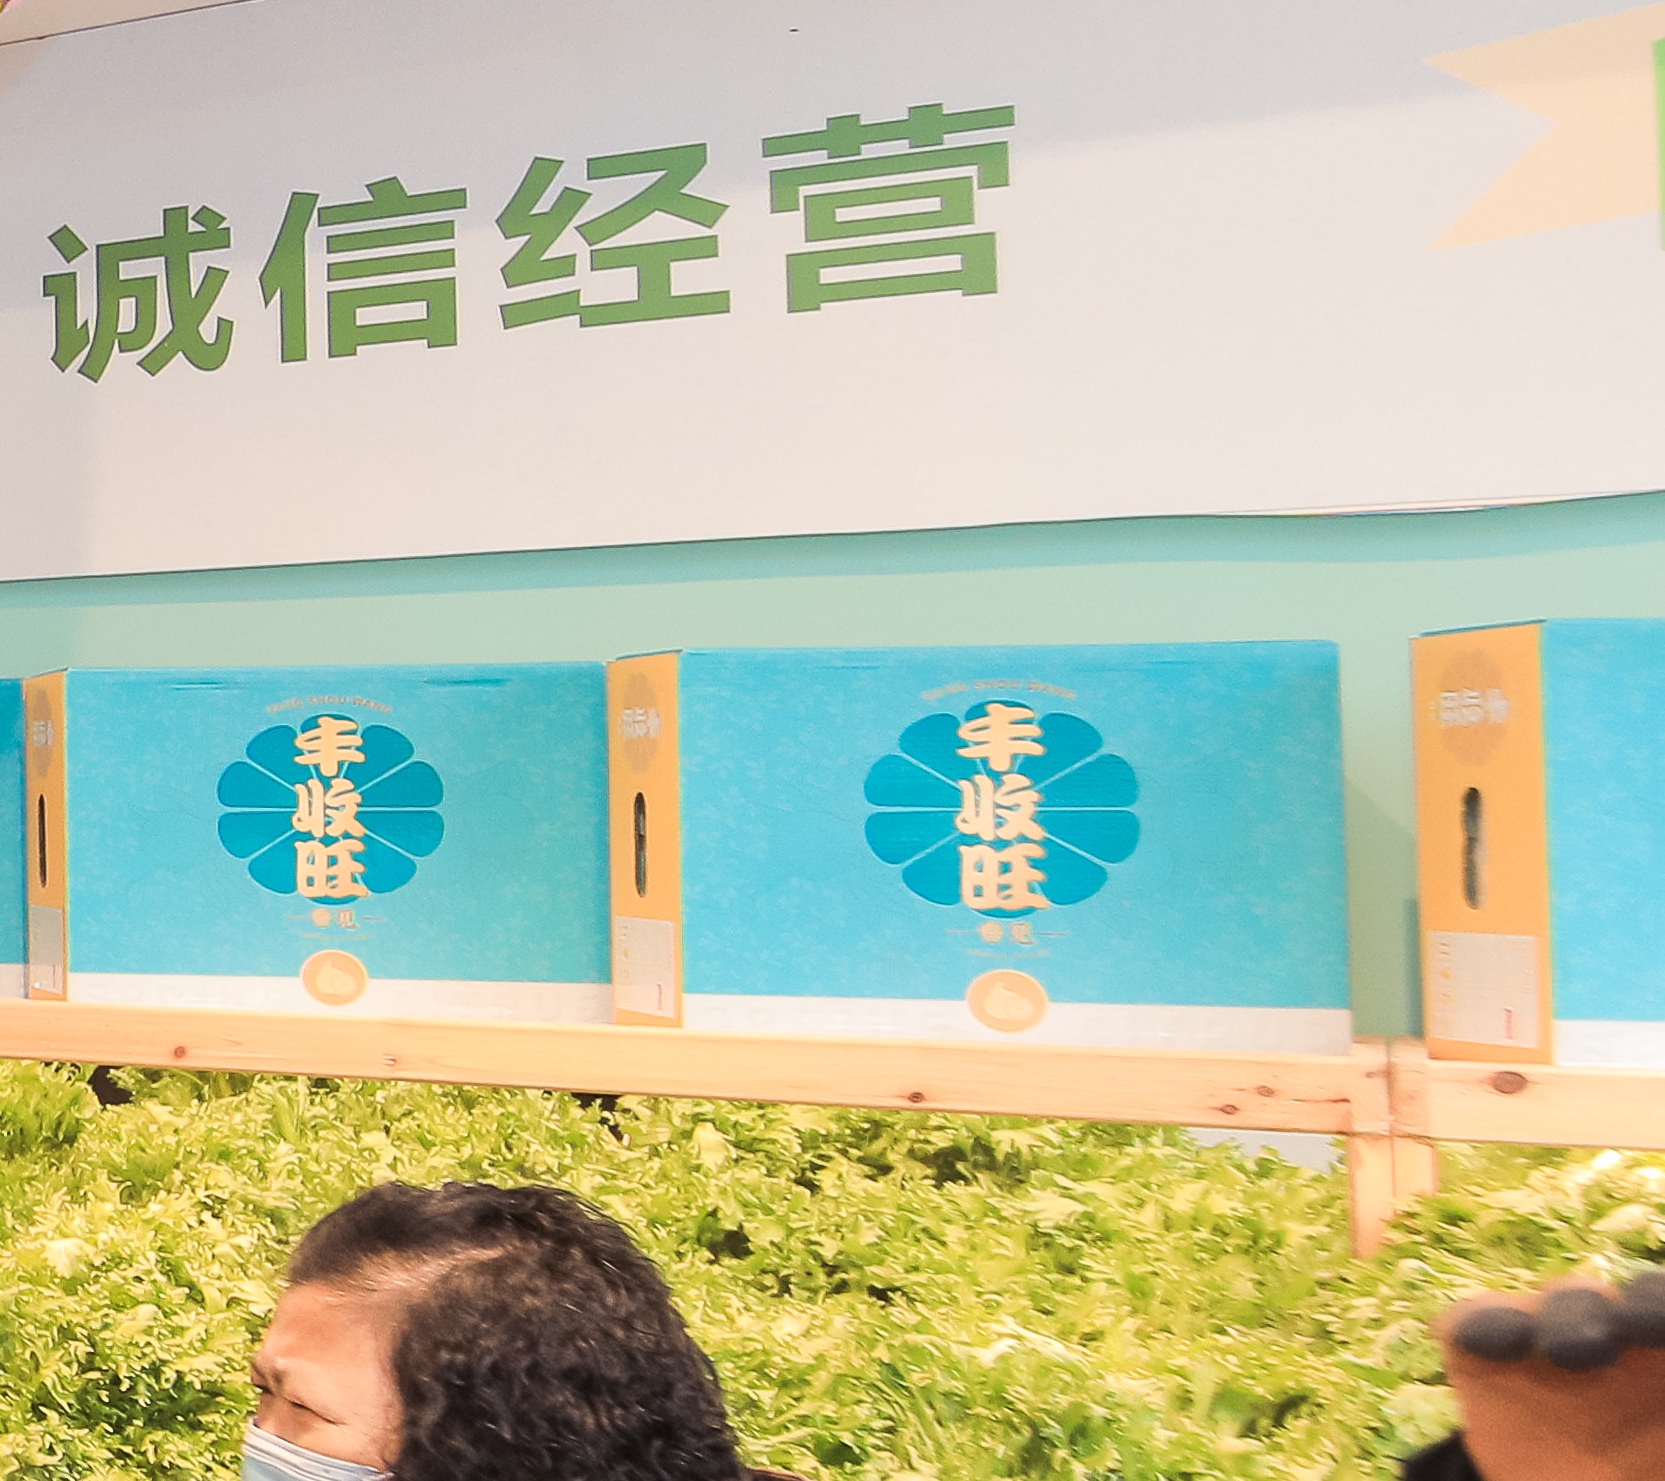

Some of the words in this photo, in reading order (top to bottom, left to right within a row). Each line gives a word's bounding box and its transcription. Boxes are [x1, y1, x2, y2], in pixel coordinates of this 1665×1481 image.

[42, 102, 1016, 384] 诚信经营
[291, 714, 370, 901] 丰收旺
[954, 701, 1051, 912] 丰收旺
